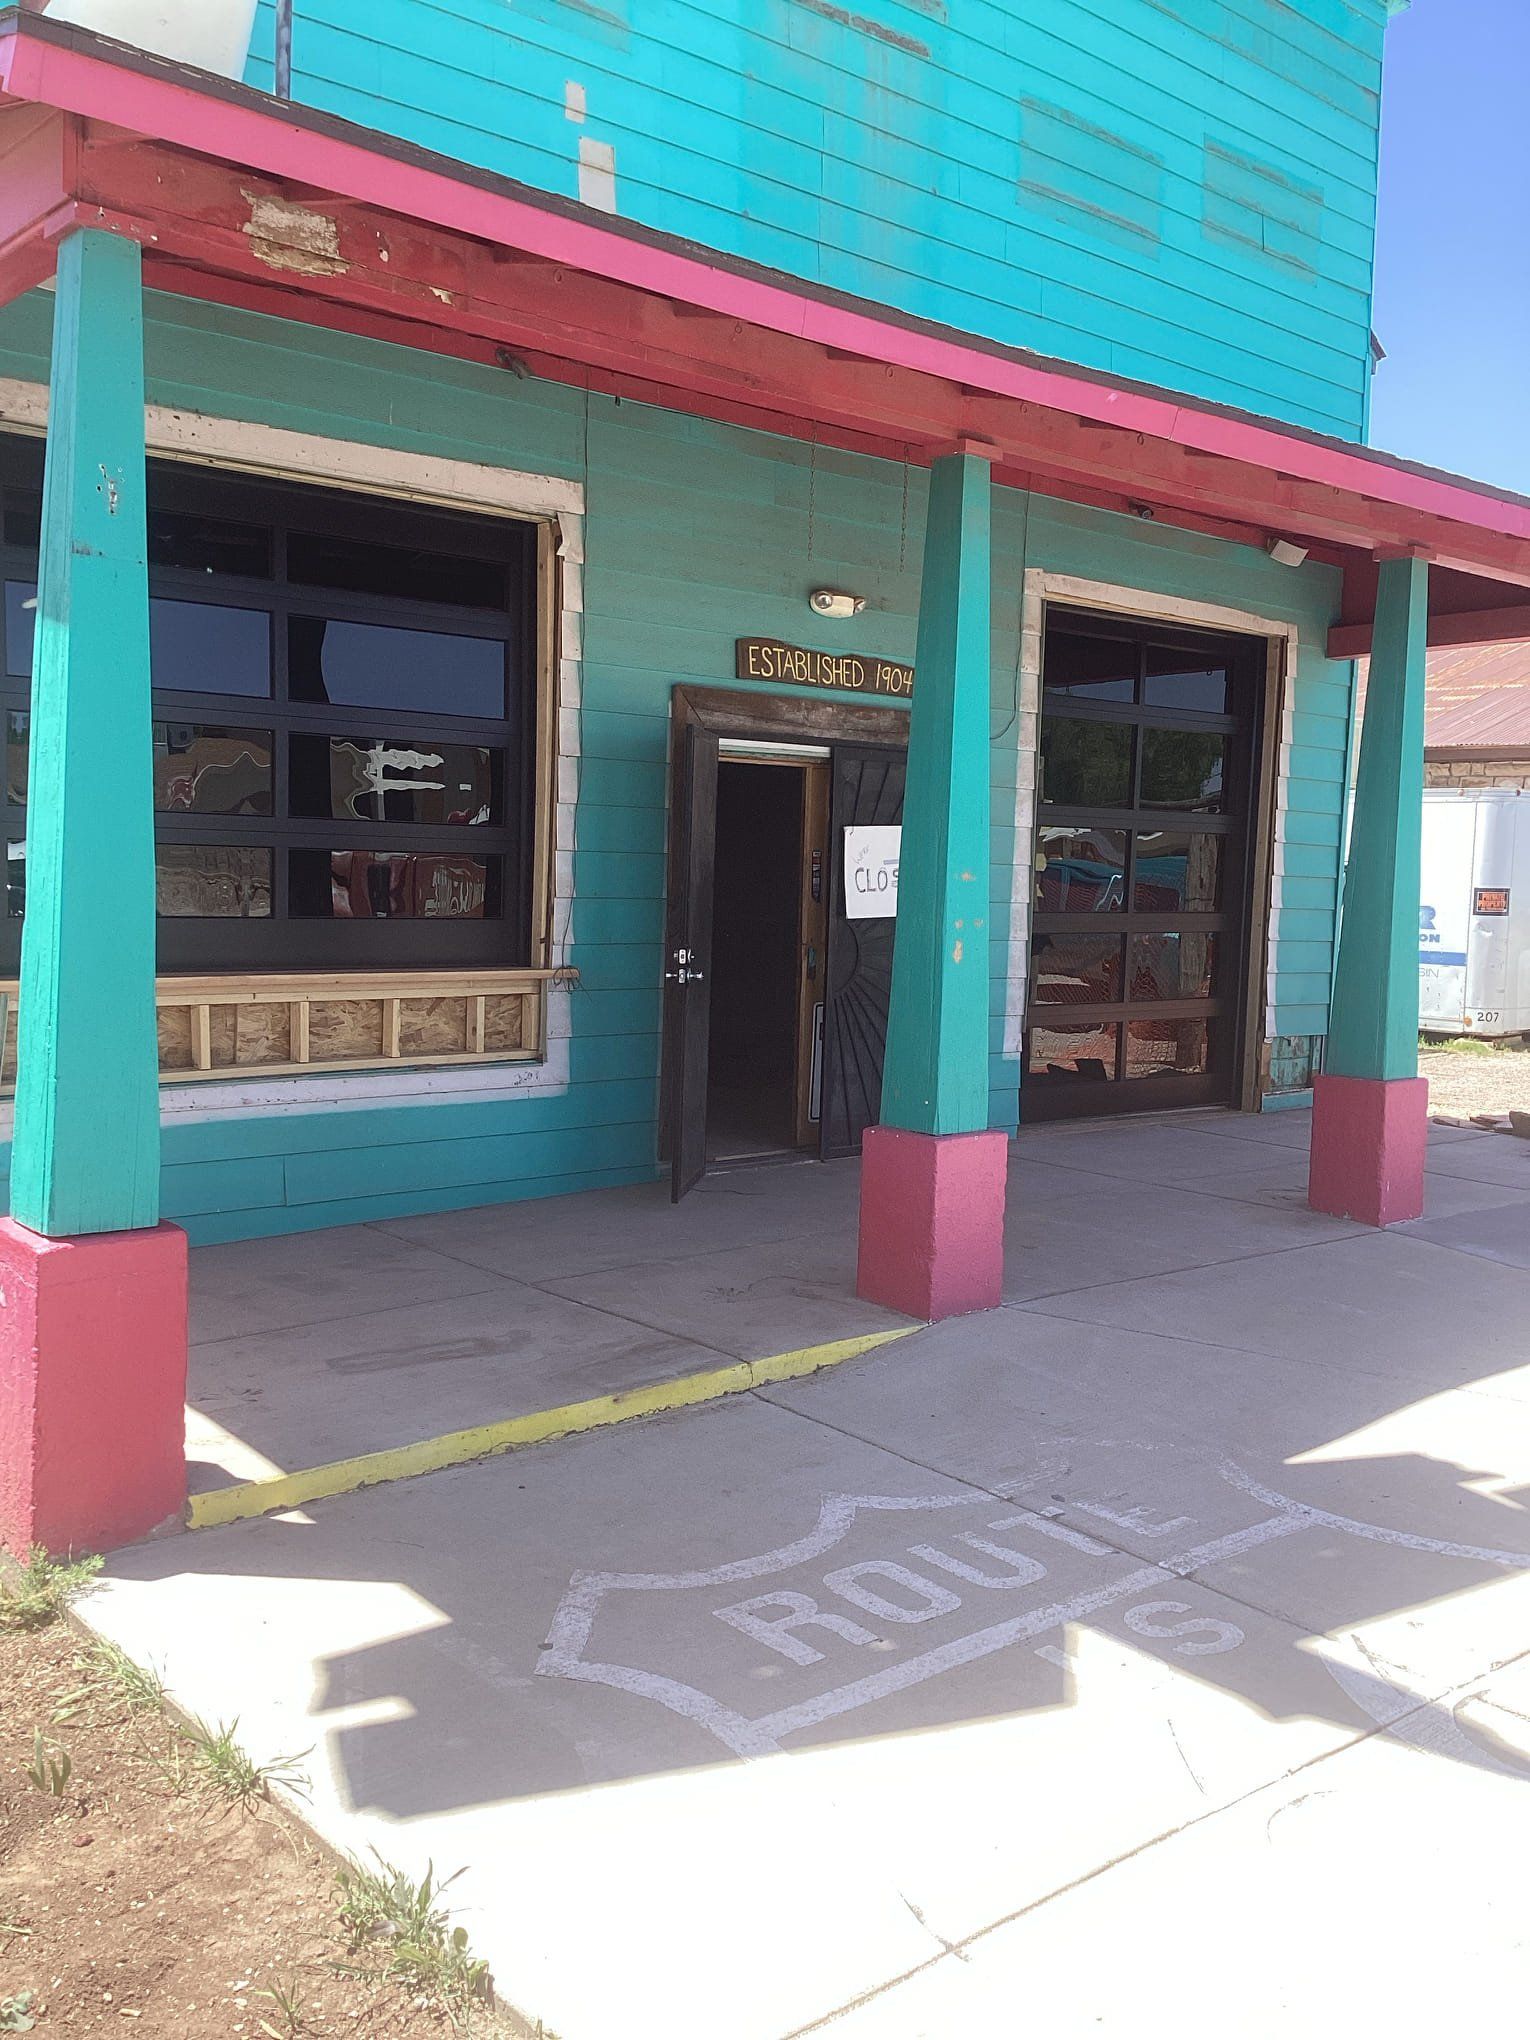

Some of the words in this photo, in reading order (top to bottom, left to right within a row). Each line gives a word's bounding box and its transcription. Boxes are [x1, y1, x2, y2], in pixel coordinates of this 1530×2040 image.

[749, 646, 865, 688] ESTABLISHED
[875, 663, 913, 694] 1904
[1477, 1012, 1499, 1023] 207
[711, 1494, 1200, 1666] ROUTE
